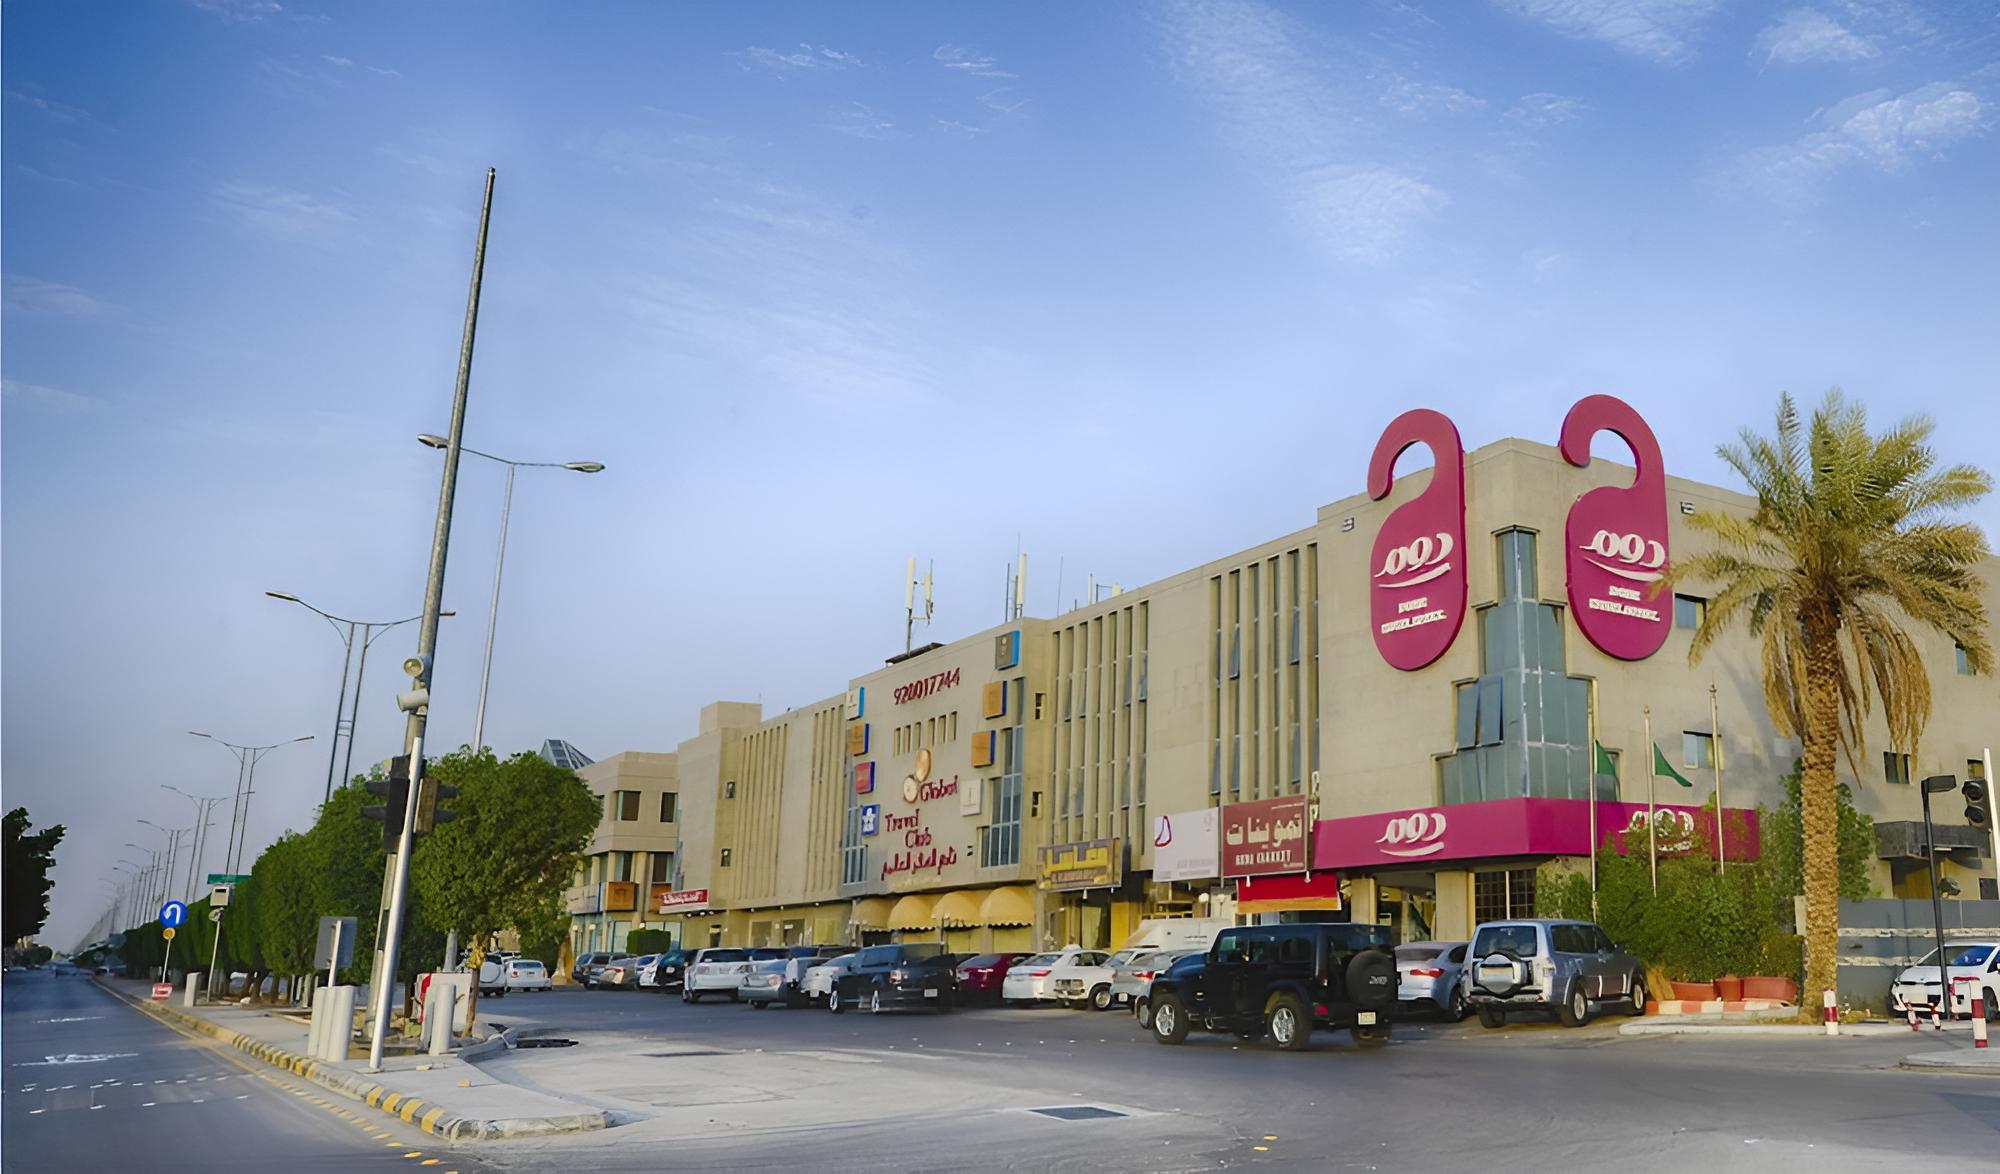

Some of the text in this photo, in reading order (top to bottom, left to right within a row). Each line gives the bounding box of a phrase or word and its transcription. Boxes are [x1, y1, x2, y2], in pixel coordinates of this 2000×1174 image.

[893, 667, 961, 705] 920017744
[920, 775, 958, 802] Global
[905, 827, 932, 848] Club
